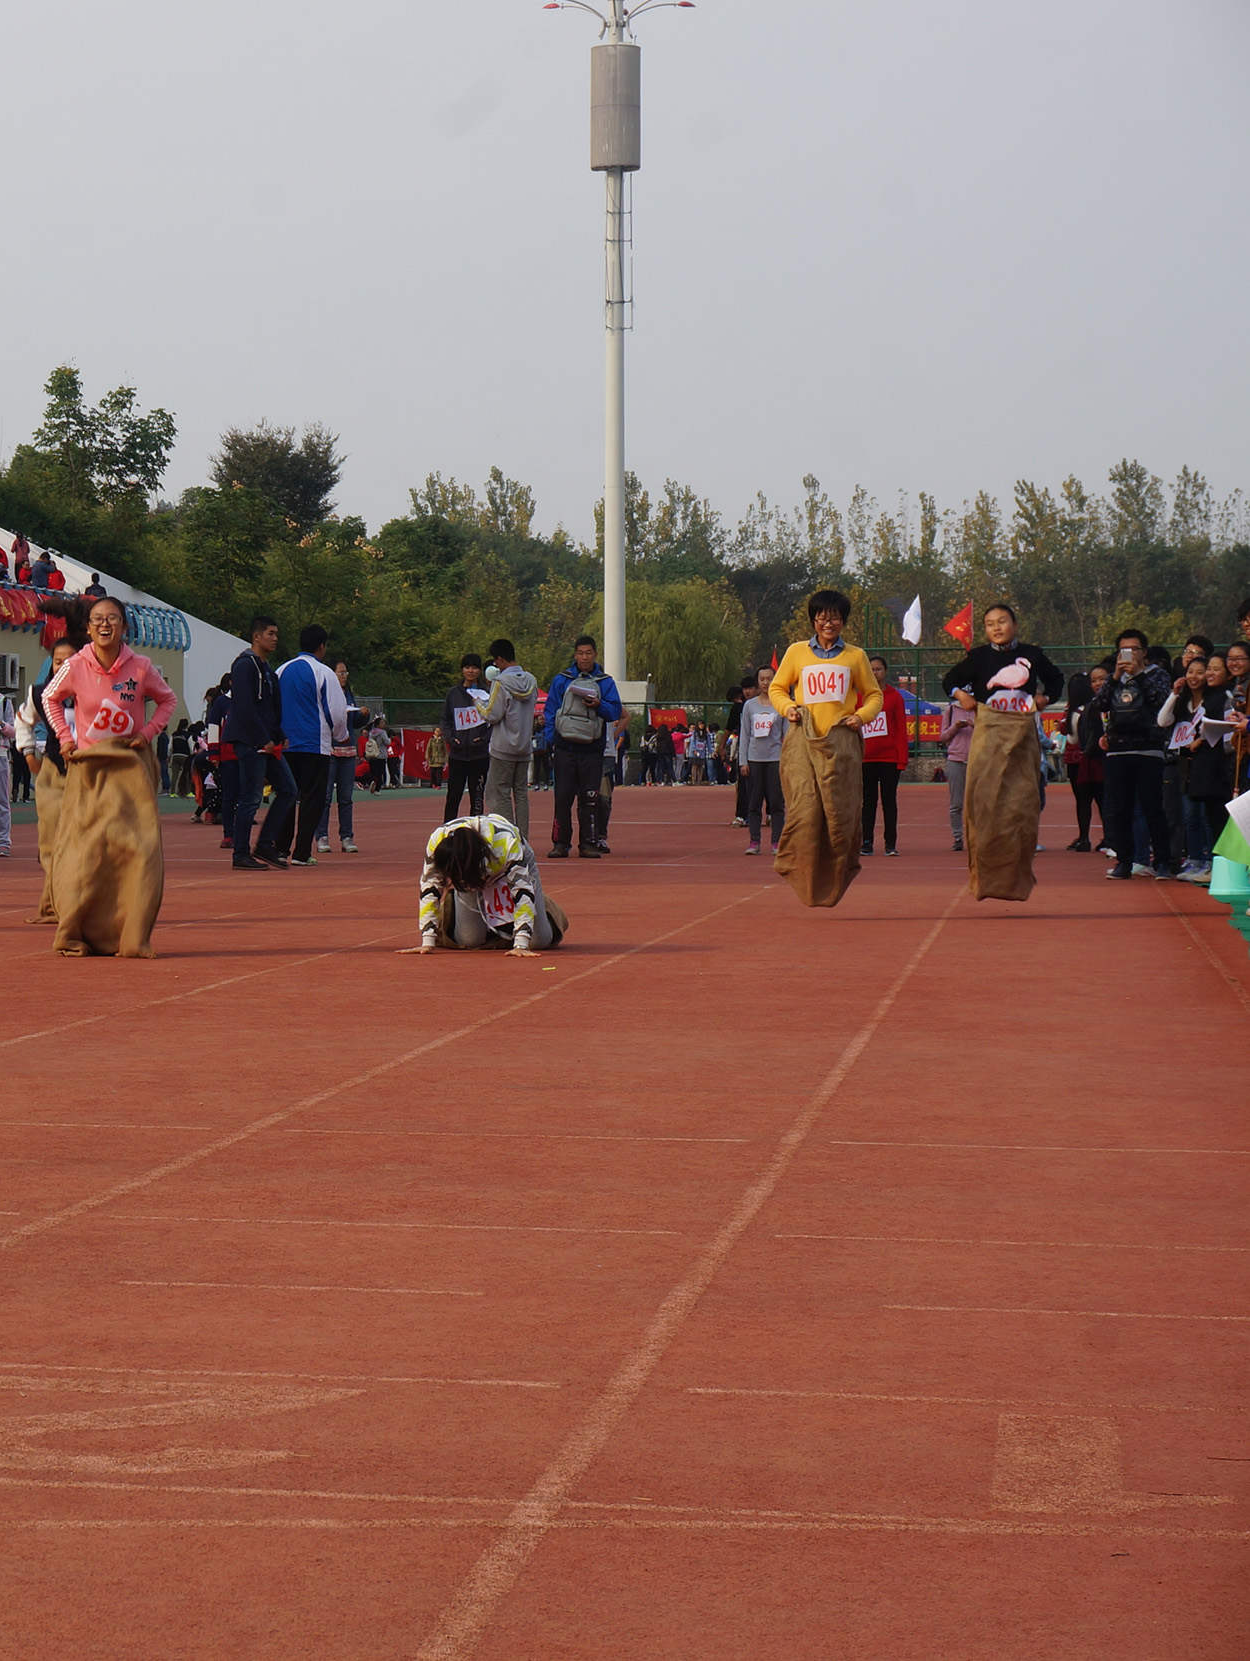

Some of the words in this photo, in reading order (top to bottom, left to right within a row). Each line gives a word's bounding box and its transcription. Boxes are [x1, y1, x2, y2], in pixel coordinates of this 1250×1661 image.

[807, 671, 845, 696] 0041
[120, 692, 135, 702] NYC
[93, 707, 130, 733] 39
